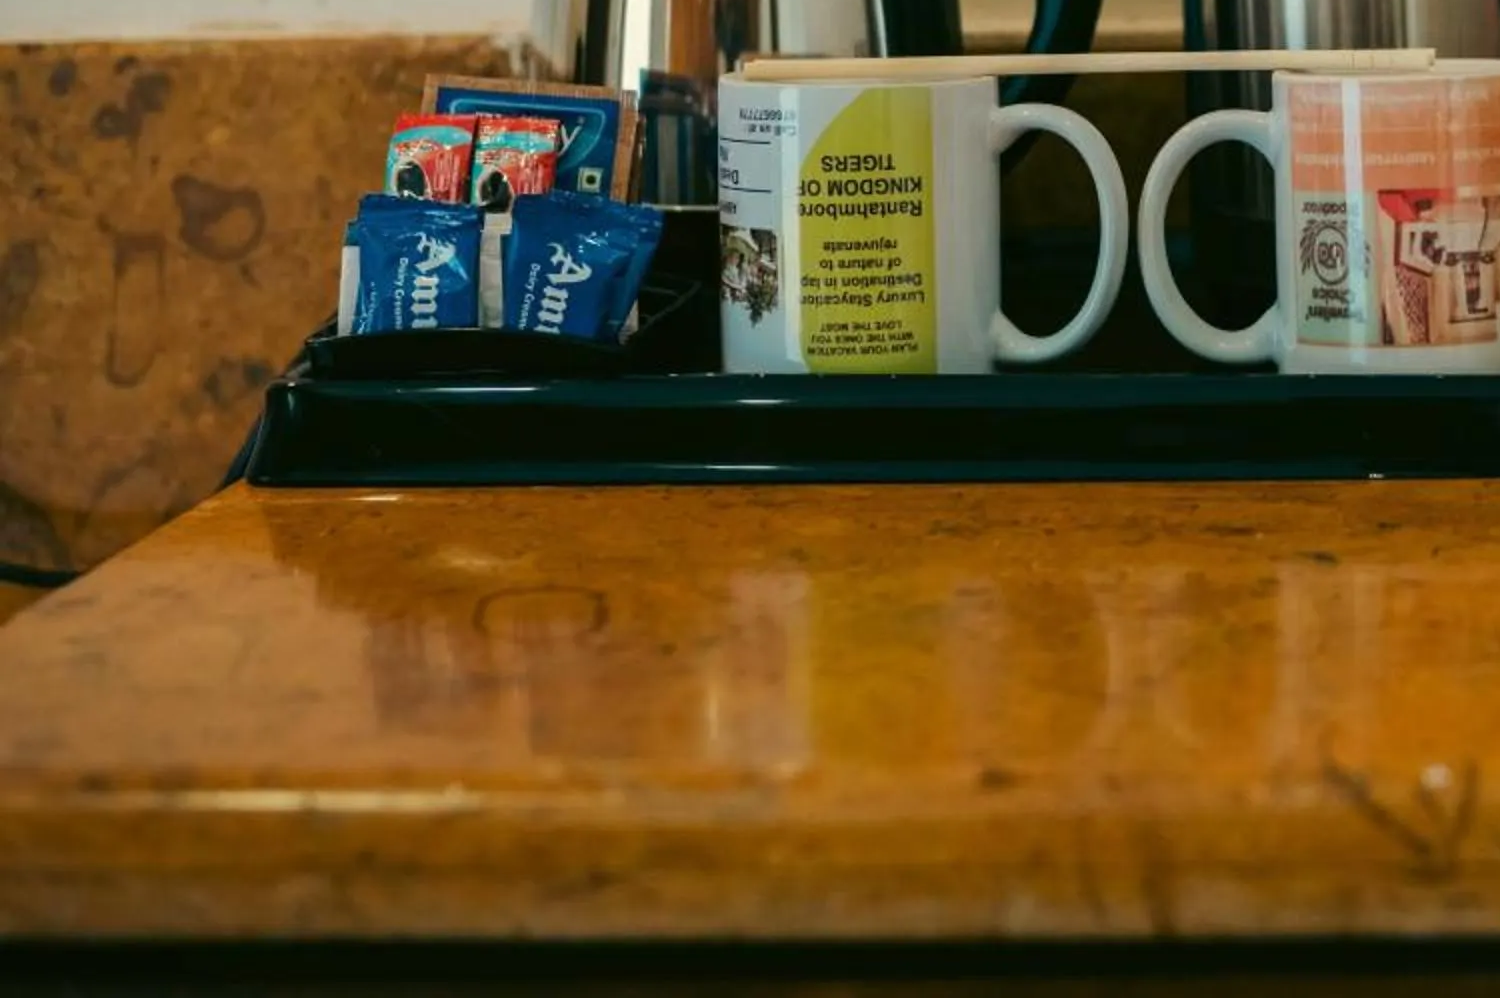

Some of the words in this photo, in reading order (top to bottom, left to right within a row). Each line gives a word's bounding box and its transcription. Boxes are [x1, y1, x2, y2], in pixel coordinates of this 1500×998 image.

[820, 153, 896, 172] TIGERS
[796, 178, 821, 195] OF
[826, 176, 923, 196] KINGDOM
[822, 237, 898, 252] rejuvenate
[819, 259, 833, 270] to
[837, 258, 884, 269] nature
[887, 257, 902, 269] of
[824, 277, 837, 288] in
[841, 273, 923, 287] Destination
[876, 290, 925, 305] Luxury
